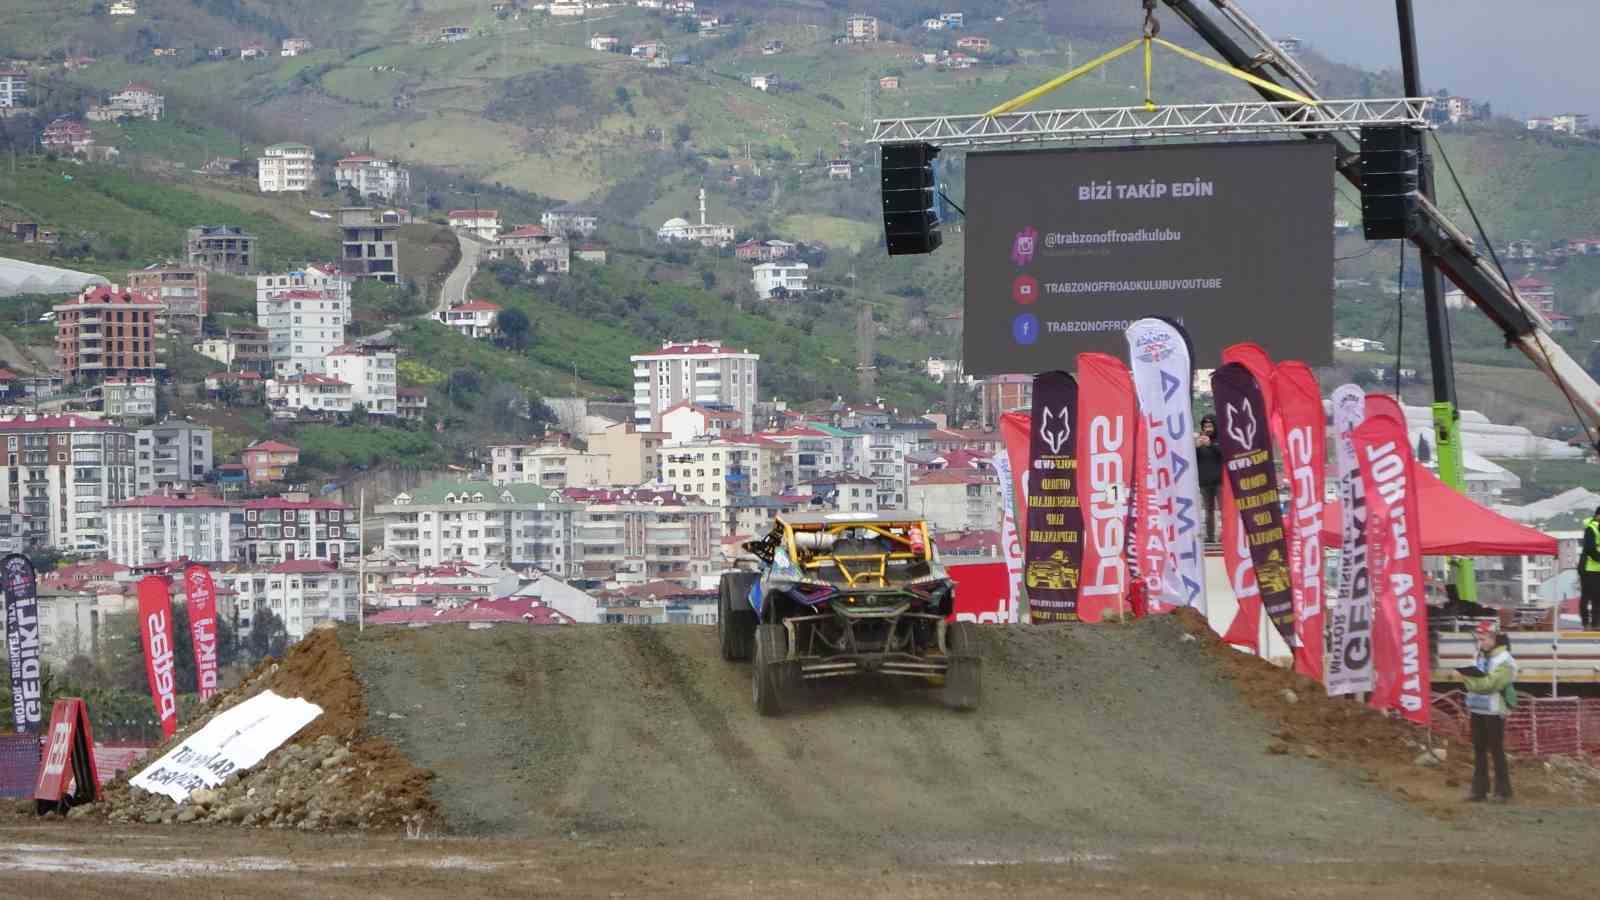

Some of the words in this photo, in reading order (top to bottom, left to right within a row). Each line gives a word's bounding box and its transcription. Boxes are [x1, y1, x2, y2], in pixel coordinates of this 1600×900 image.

[1078, 180, 1113, 201] BİZİ
[1117, 178, 1167, 199] TAKİP
[1172, 176, 1214, 197] EDİN
[1045, 228, 1181, 248] @trabzonoffroadkulubu
[1045, 278, 1223, 294] TRABZONOFFROADKULUBUYOUTUBE
[1111, 485, 1118, 501] 1
